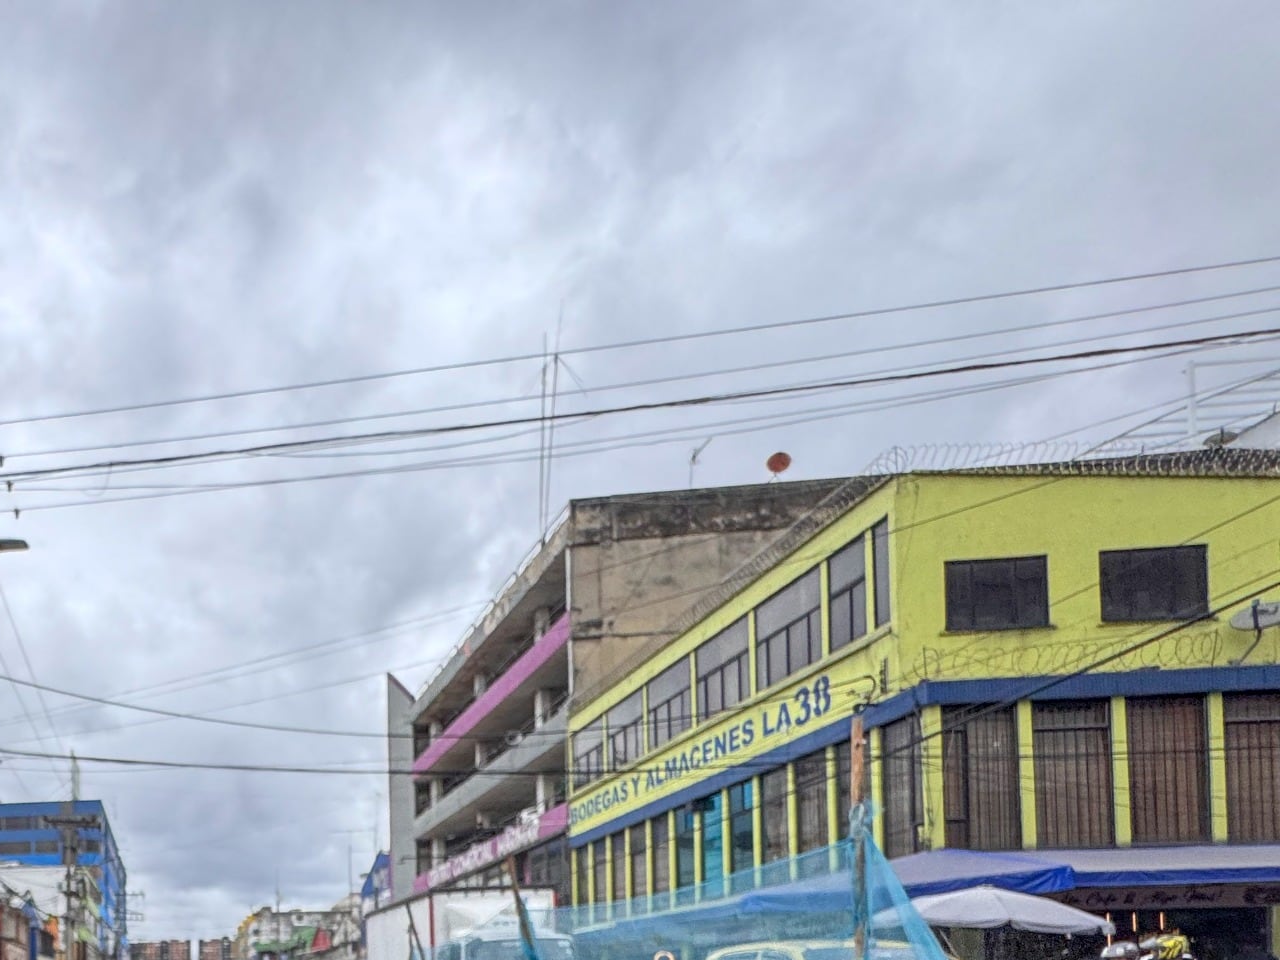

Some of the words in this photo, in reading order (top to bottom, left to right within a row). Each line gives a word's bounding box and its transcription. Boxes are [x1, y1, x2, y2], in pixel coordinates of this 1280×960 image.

[570, 780, 629, 825] BODEGAS
[631, 775, 641, 798] Y
[645, 719, 755, 791] ALMACENES
